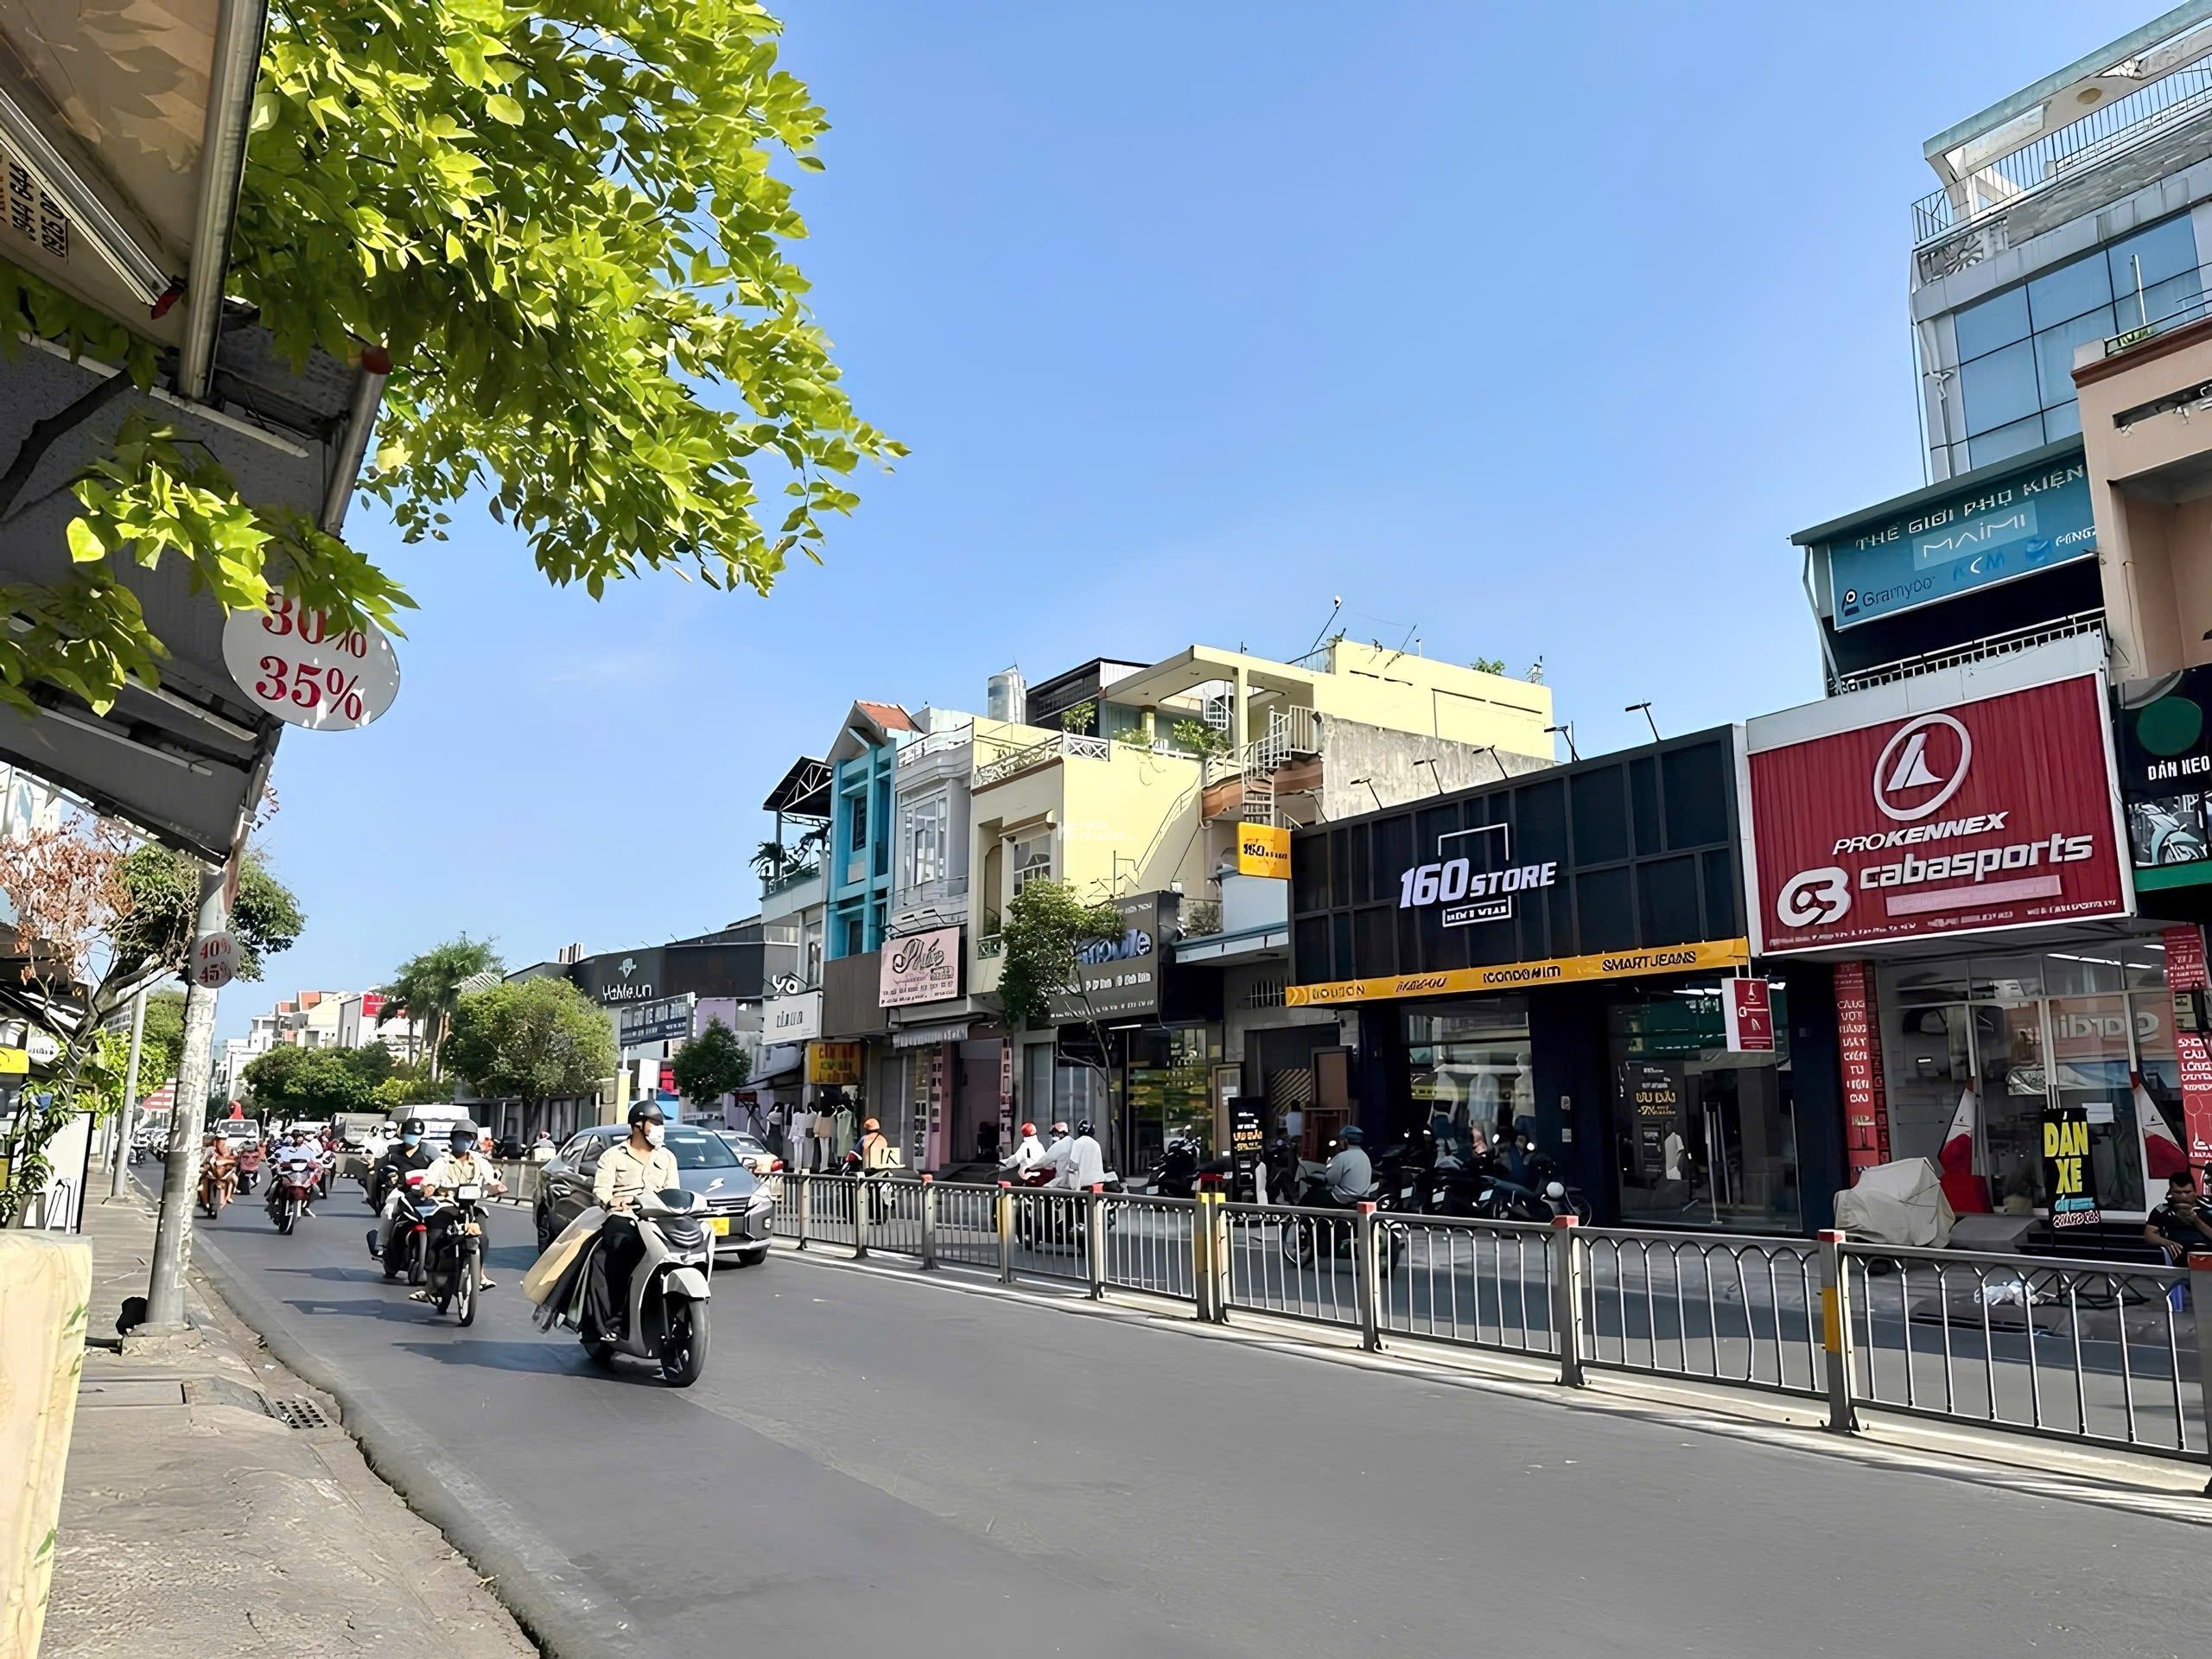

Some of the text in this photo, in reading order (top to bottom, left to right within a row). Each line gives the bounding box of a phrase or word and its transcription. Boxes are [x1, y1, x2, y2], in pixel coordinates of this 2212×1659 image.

[256, 656, 362, 721] 35%
[1832, 810, 2010, 855] PROKENNEX
[1400, 858, 1557, 908] 160 STORE
[1859, 832, 2093, 890] cabasports
[2044, 1111, 2088, 1157] DÁN
[2056, 1158, 2082, 1193] XE
